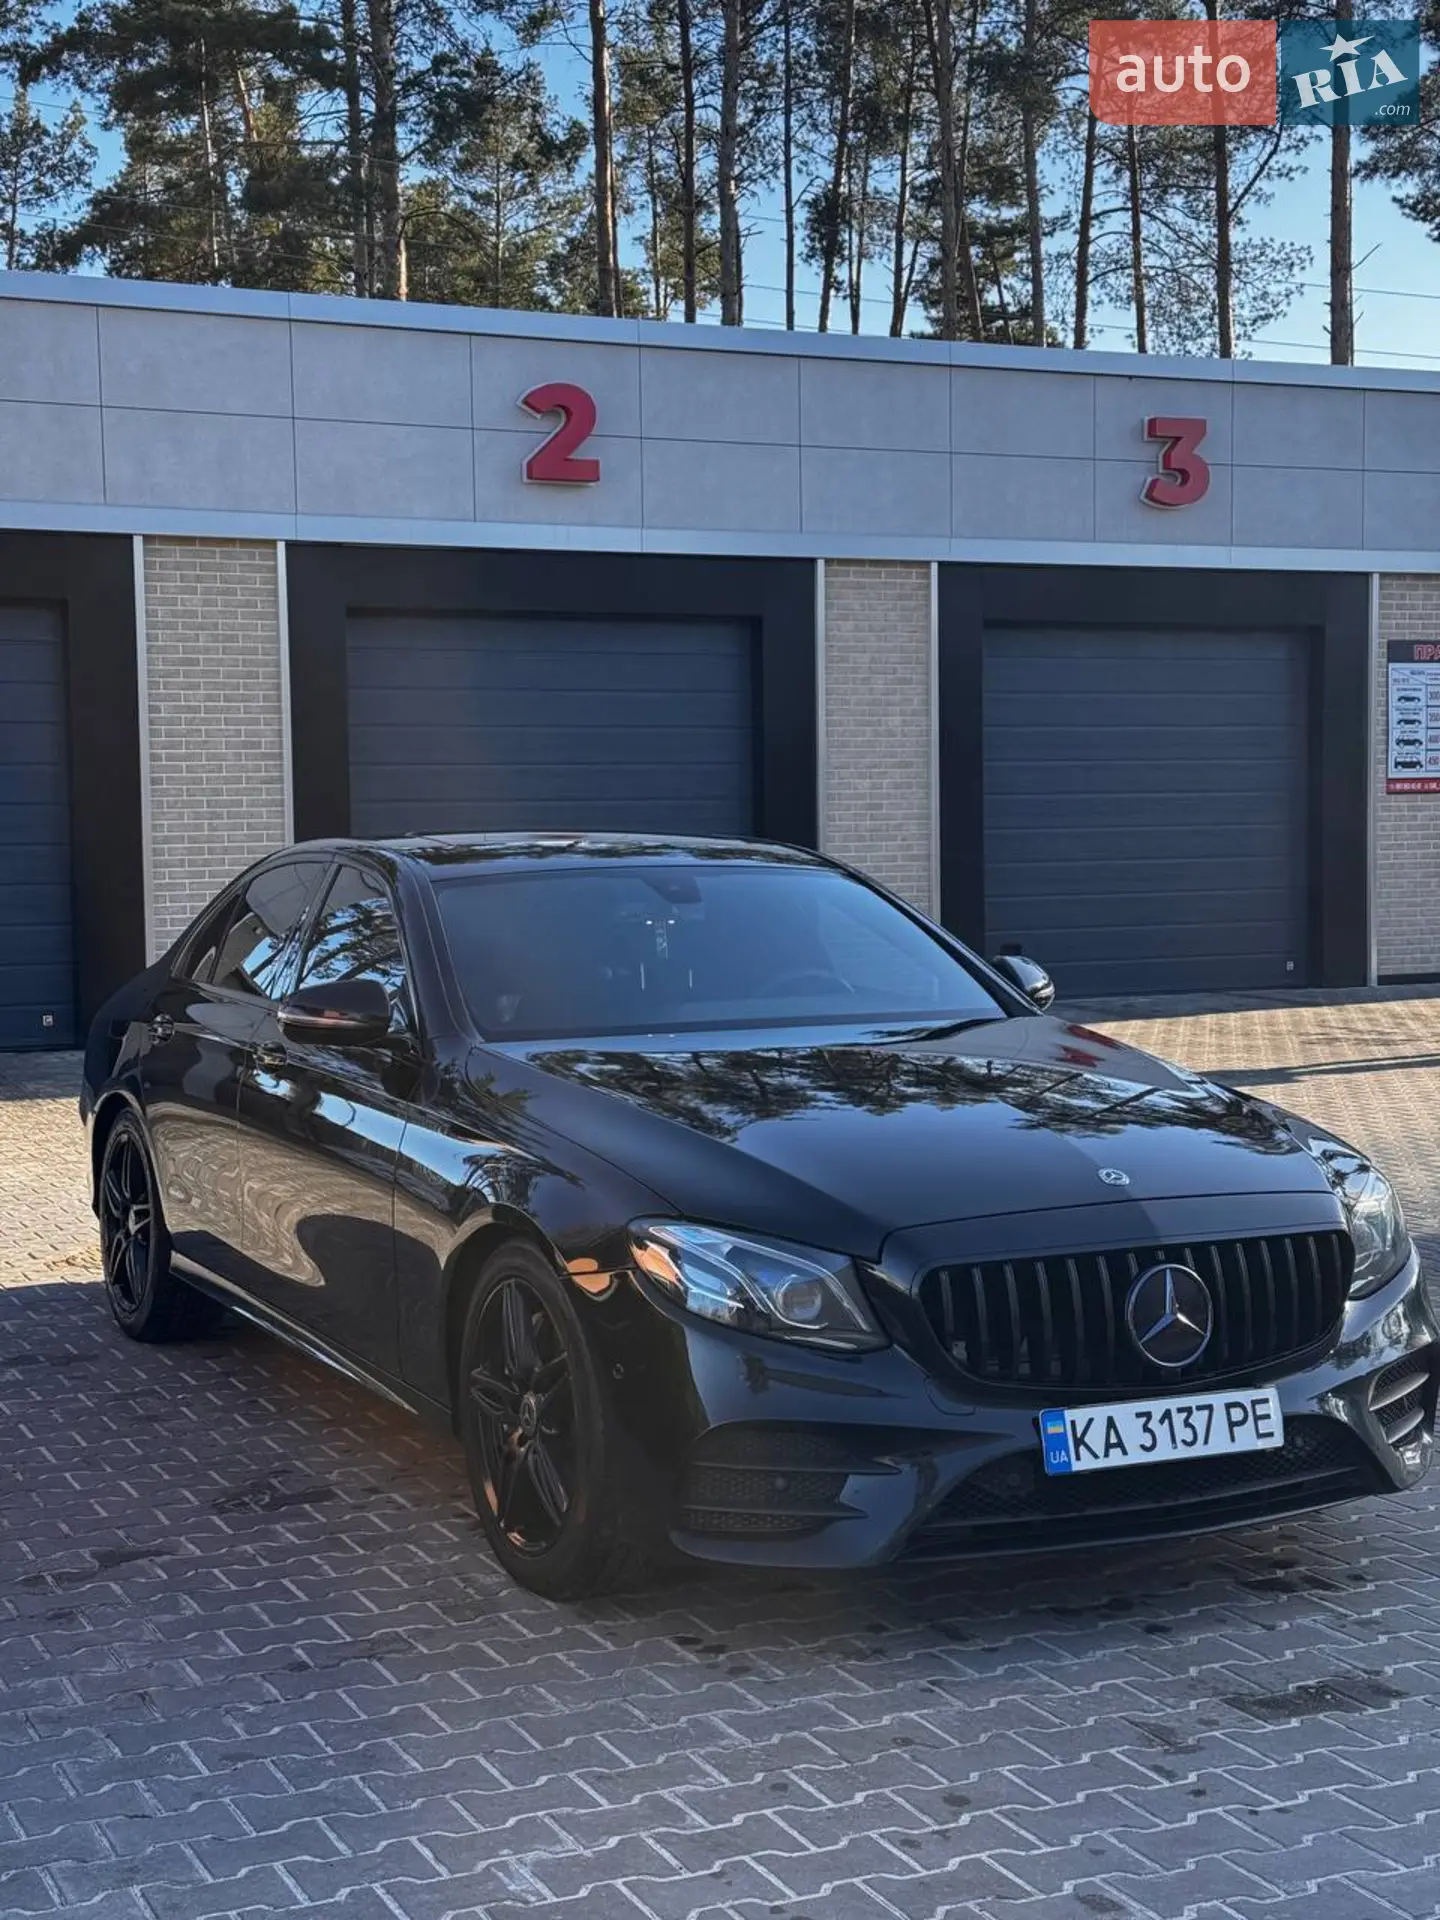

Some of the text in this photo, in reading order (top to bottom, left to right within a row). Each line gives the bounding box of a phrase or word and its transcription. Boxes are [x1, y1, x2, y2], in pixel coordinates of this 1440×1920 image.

[516, 382, 600, 485] 2
[1140, 414, 1211, 509] 3
[1050, 1450, 1069, 1464] UA
[1135, 1403, 1214, 1453] 3137
